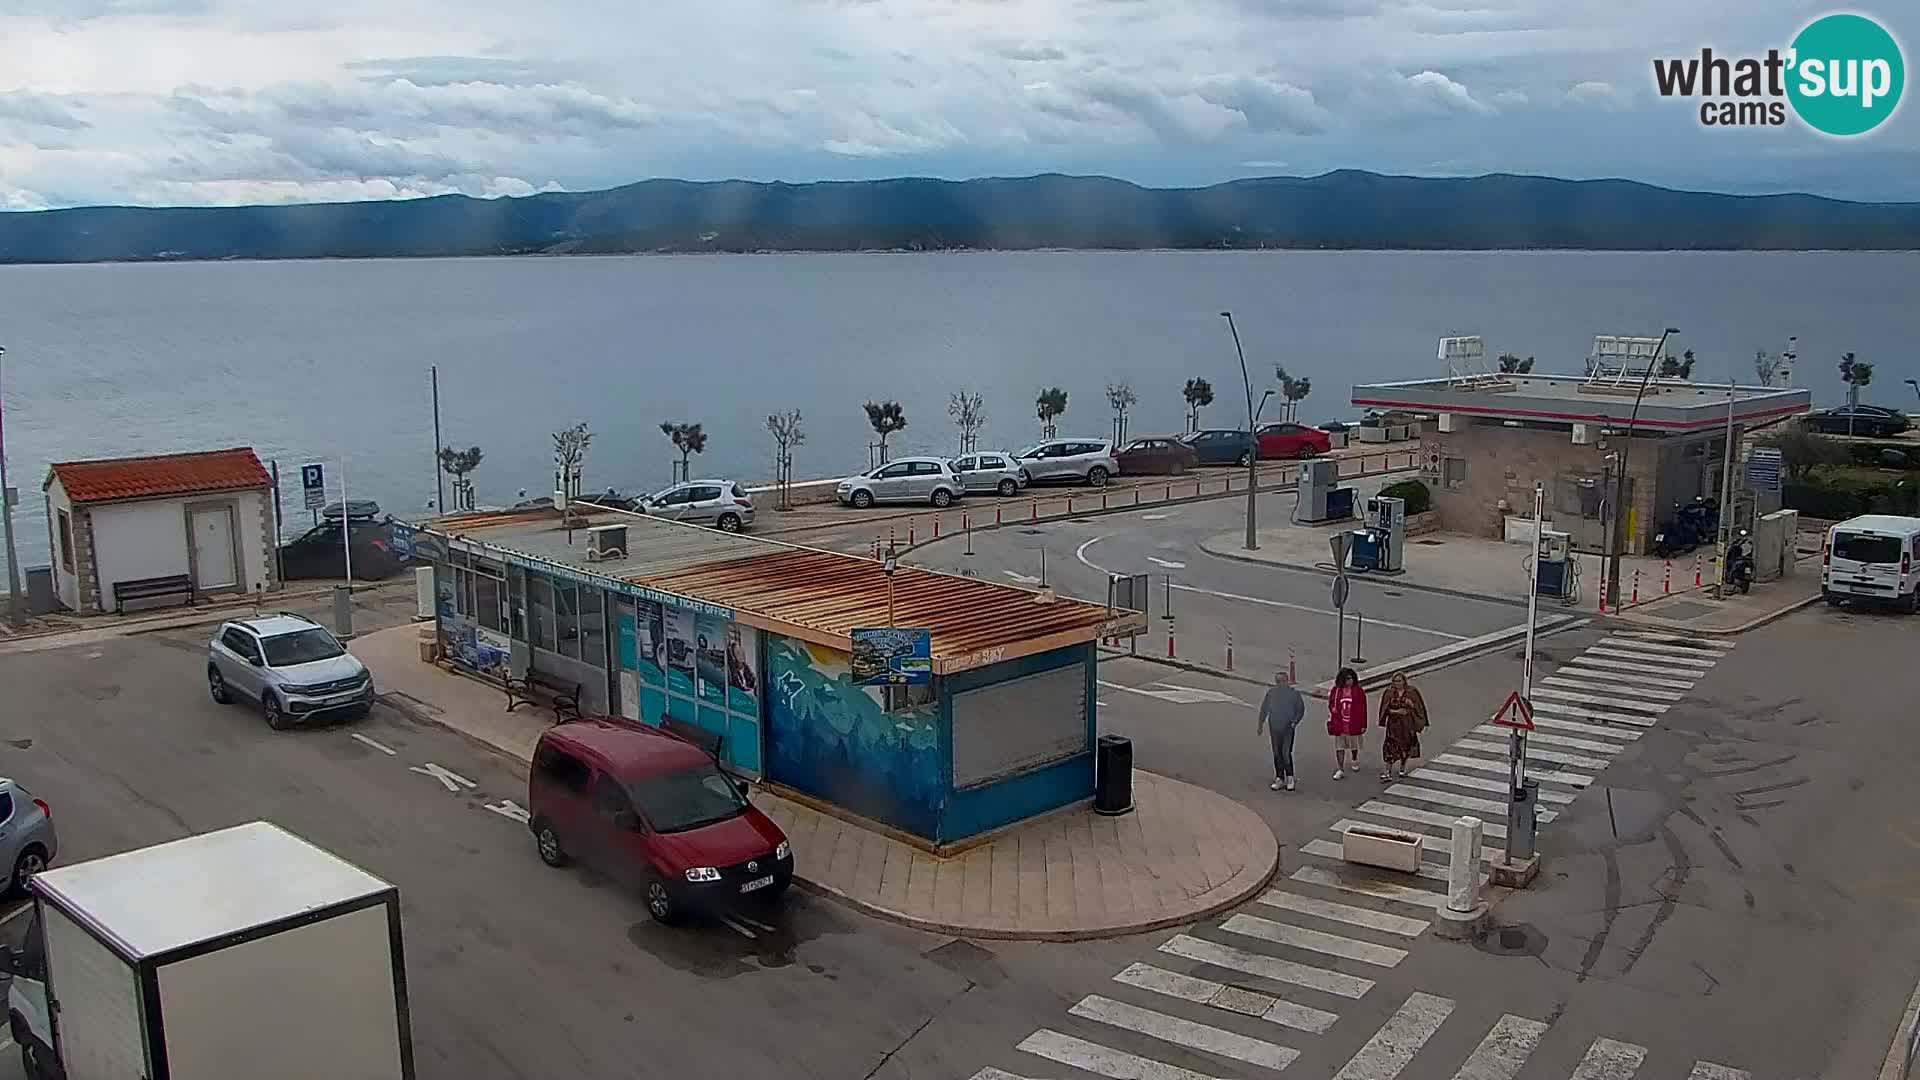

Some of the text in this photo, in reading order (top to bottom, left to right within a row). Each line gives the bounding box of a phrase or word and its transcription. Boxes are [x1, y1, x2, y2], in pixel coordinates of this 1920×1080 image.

[307, 468, 318, 485] P
[630, 586, 645, 597] BUS
[646, 590, 676, 605] STATION
[679, 598, 704, 611] TICKET
[704, 604, 731, 618] OFFICE
